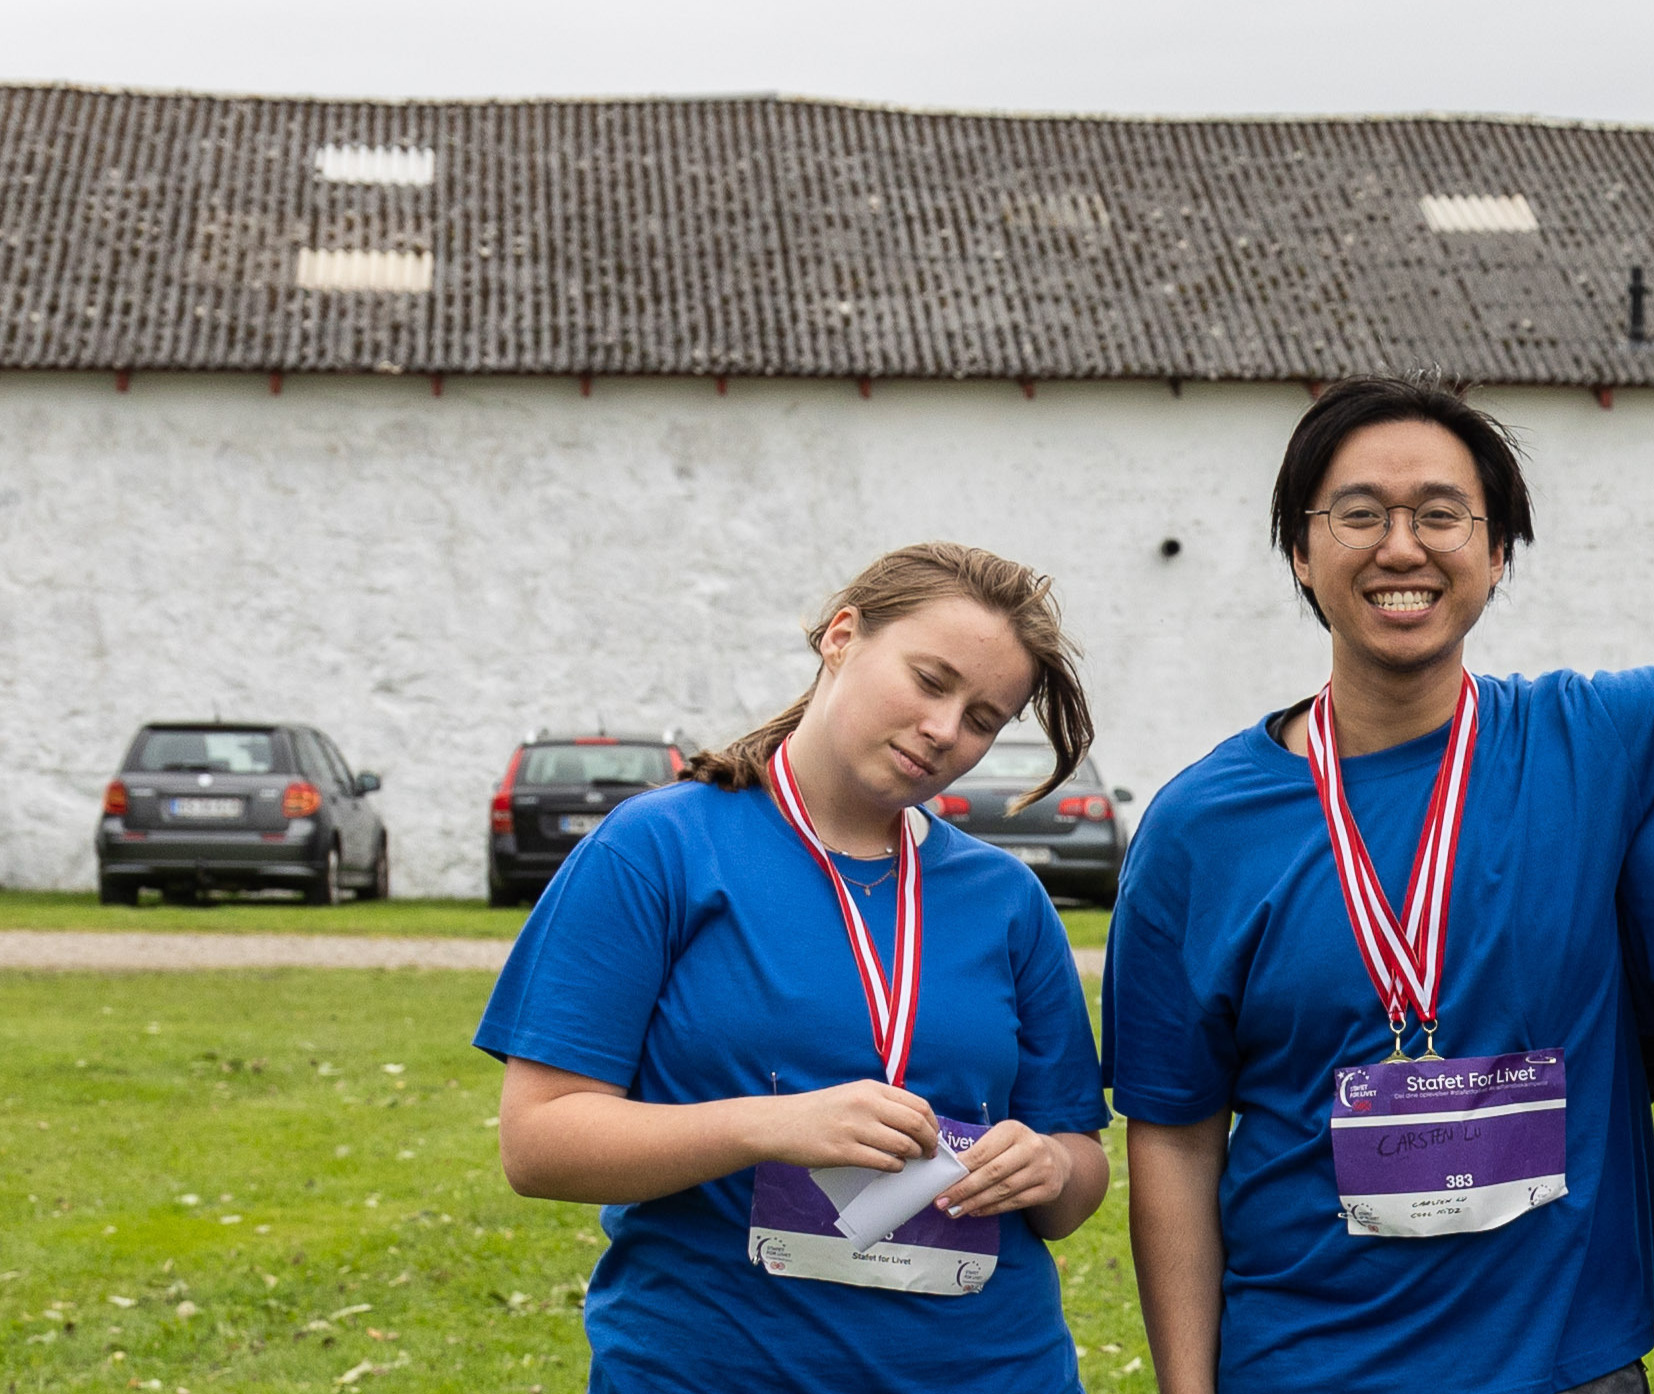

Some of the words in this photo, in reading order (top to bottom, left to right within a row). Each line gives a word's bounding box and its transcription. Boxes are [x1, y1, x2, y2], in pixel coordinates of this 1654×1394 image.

[1406, 1073, 1464, 1092] Stafet
[1469, 1071, 1494, 1088] For
[1496, 1066, 1537, 1084] Livet
[945, 1131, 975, 1150] ivet
[1378, 1128, 1454, 1157] CARSTEN
[1446, 1174, 1474, 1188] 383
[852, 1251, 877, 1262] Stafet
[878, 1254, 890, 1262] for
[891, 1256, 912, 1265] Livet
